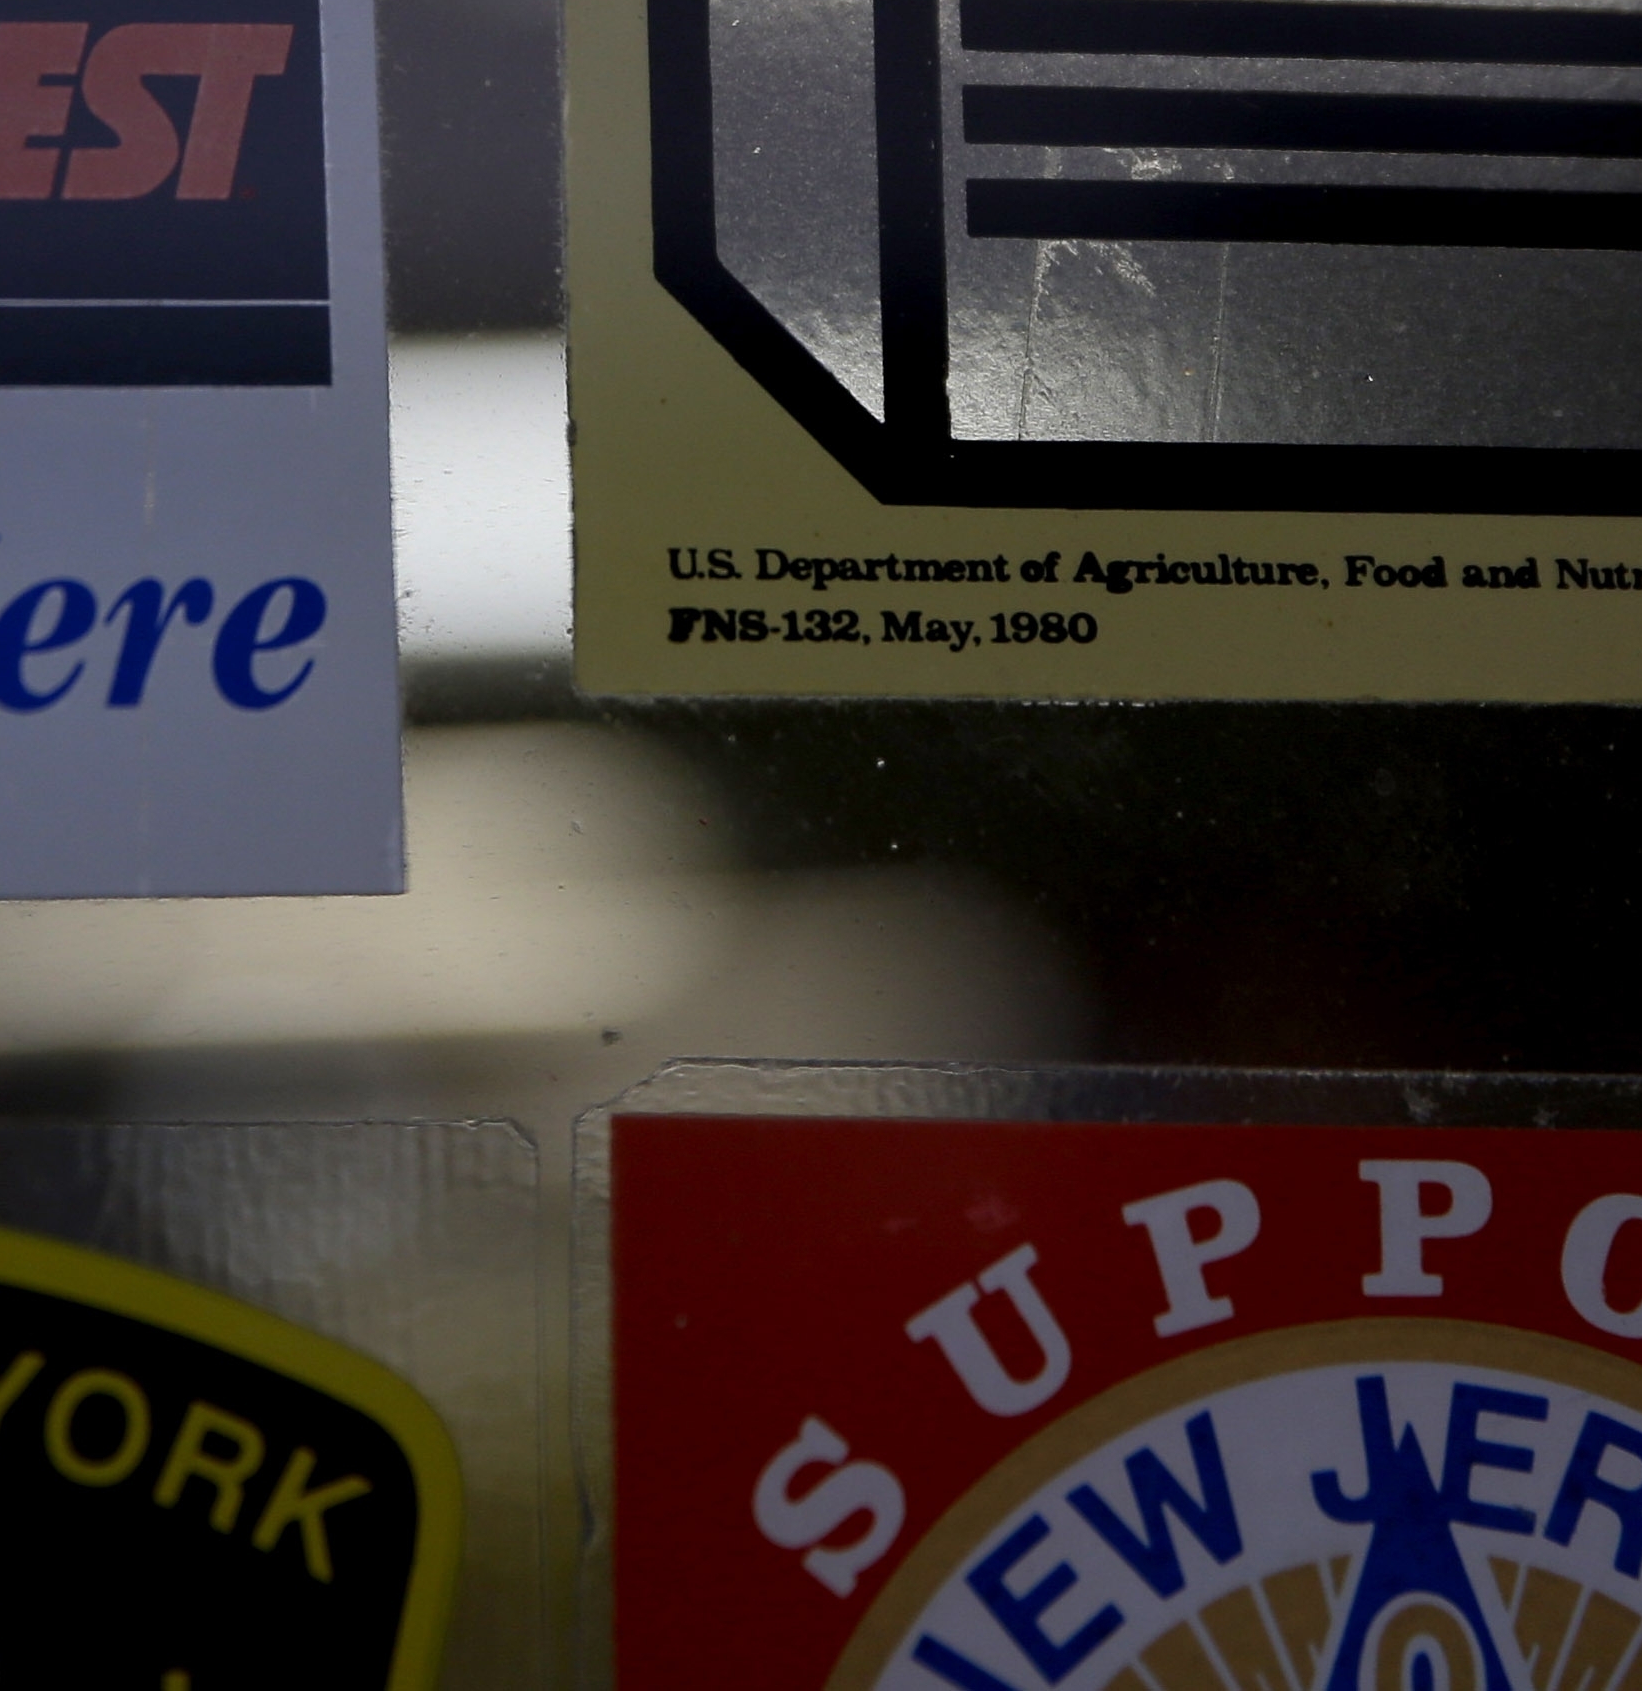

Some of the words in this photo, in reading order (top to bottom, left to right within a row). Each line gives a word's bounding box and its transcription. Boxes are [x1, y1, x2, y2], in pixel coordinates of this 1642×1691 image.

[667, 547, 743, 580] U.S.
[756, 548, 1010, 591] Department
[1019, 550, 1060, 583] of
[1072, 551, 1330, 593] Agriculture,
[1343, 554, 1448, 589] Food
[1462, 557, 1541, 589] and
[667, 607, 871, 646] FNS-132,
[879, 611, 983, 653] May,
[989, 612, 1099, 645] 1980
[910, 1410, 1245, 1691] EW
